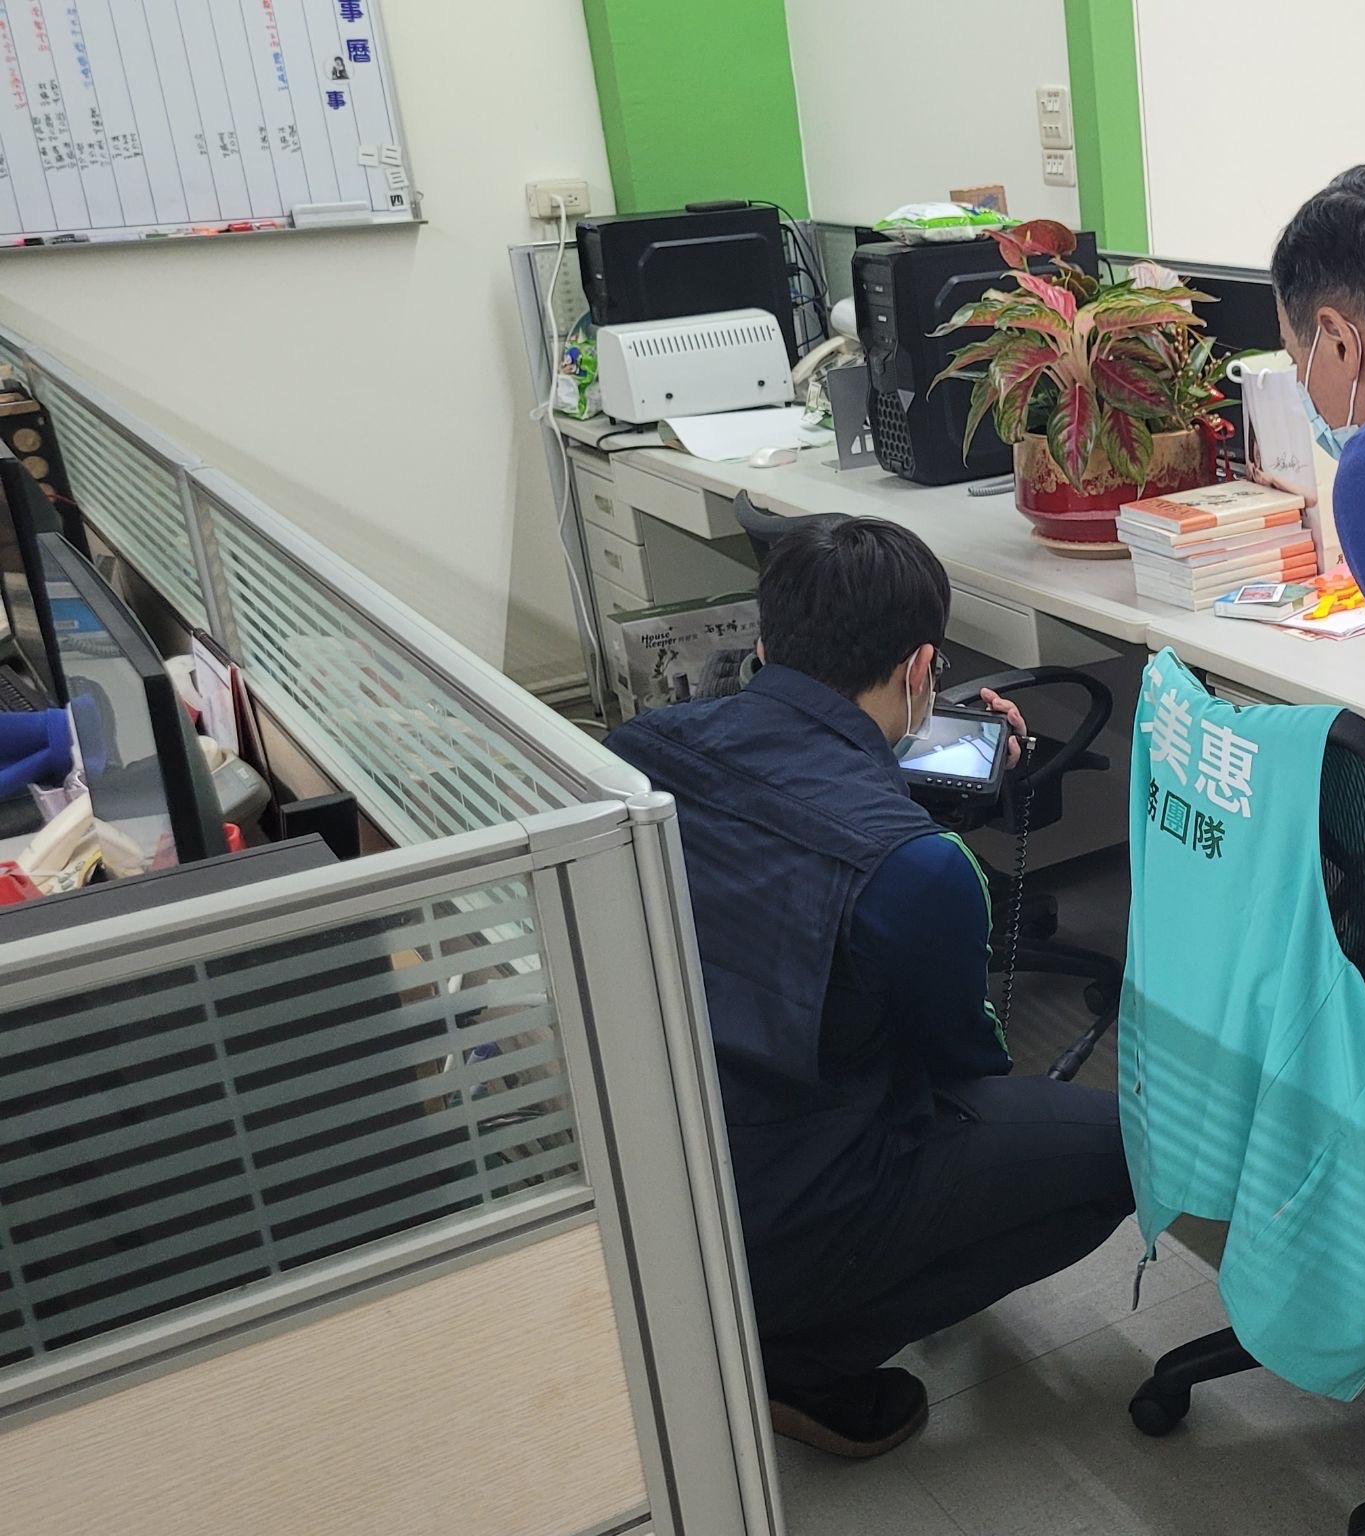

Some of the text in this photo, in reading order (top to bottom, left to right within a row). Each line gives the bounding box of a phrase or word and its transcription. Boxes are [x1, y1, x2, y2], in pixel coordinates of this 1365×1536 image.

[325, 90, 347, 110] 事
[390, 170, 405, 185] 三
[389, 194, 405, 207] 四
[641, 631, 671, 646] House
